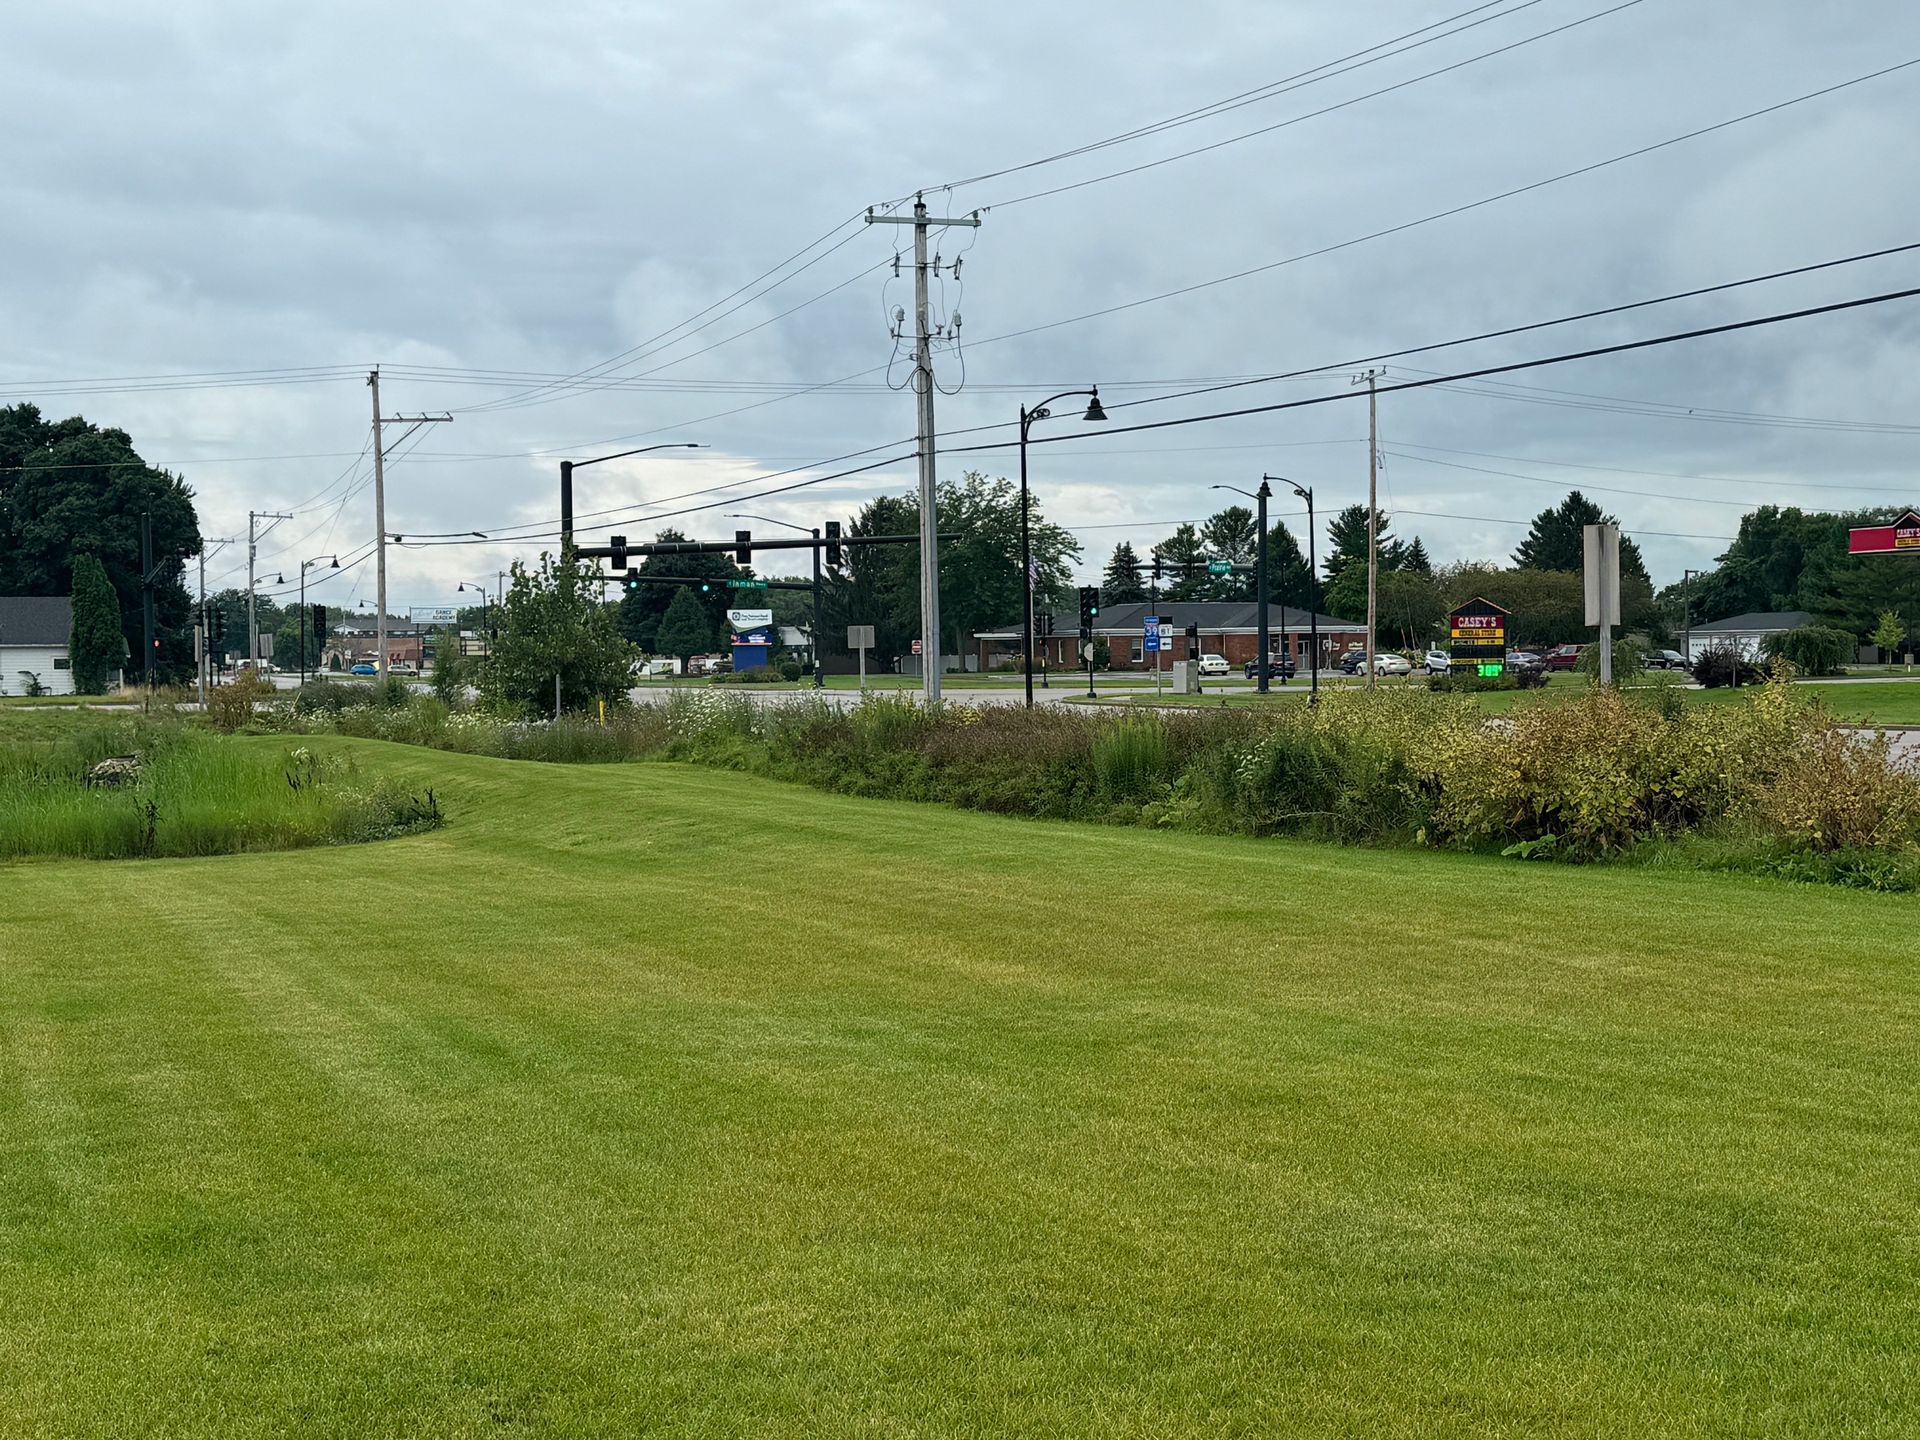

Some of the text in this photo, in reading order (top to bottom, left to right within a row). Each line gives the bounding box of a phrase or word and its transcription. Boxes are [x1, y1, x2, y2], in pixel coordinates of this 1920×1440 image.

[732, 579, 755, 588] Inman
[1458, 616, 1497, 628] CASEY'S
[1145, 626, 1158, 636] 39
